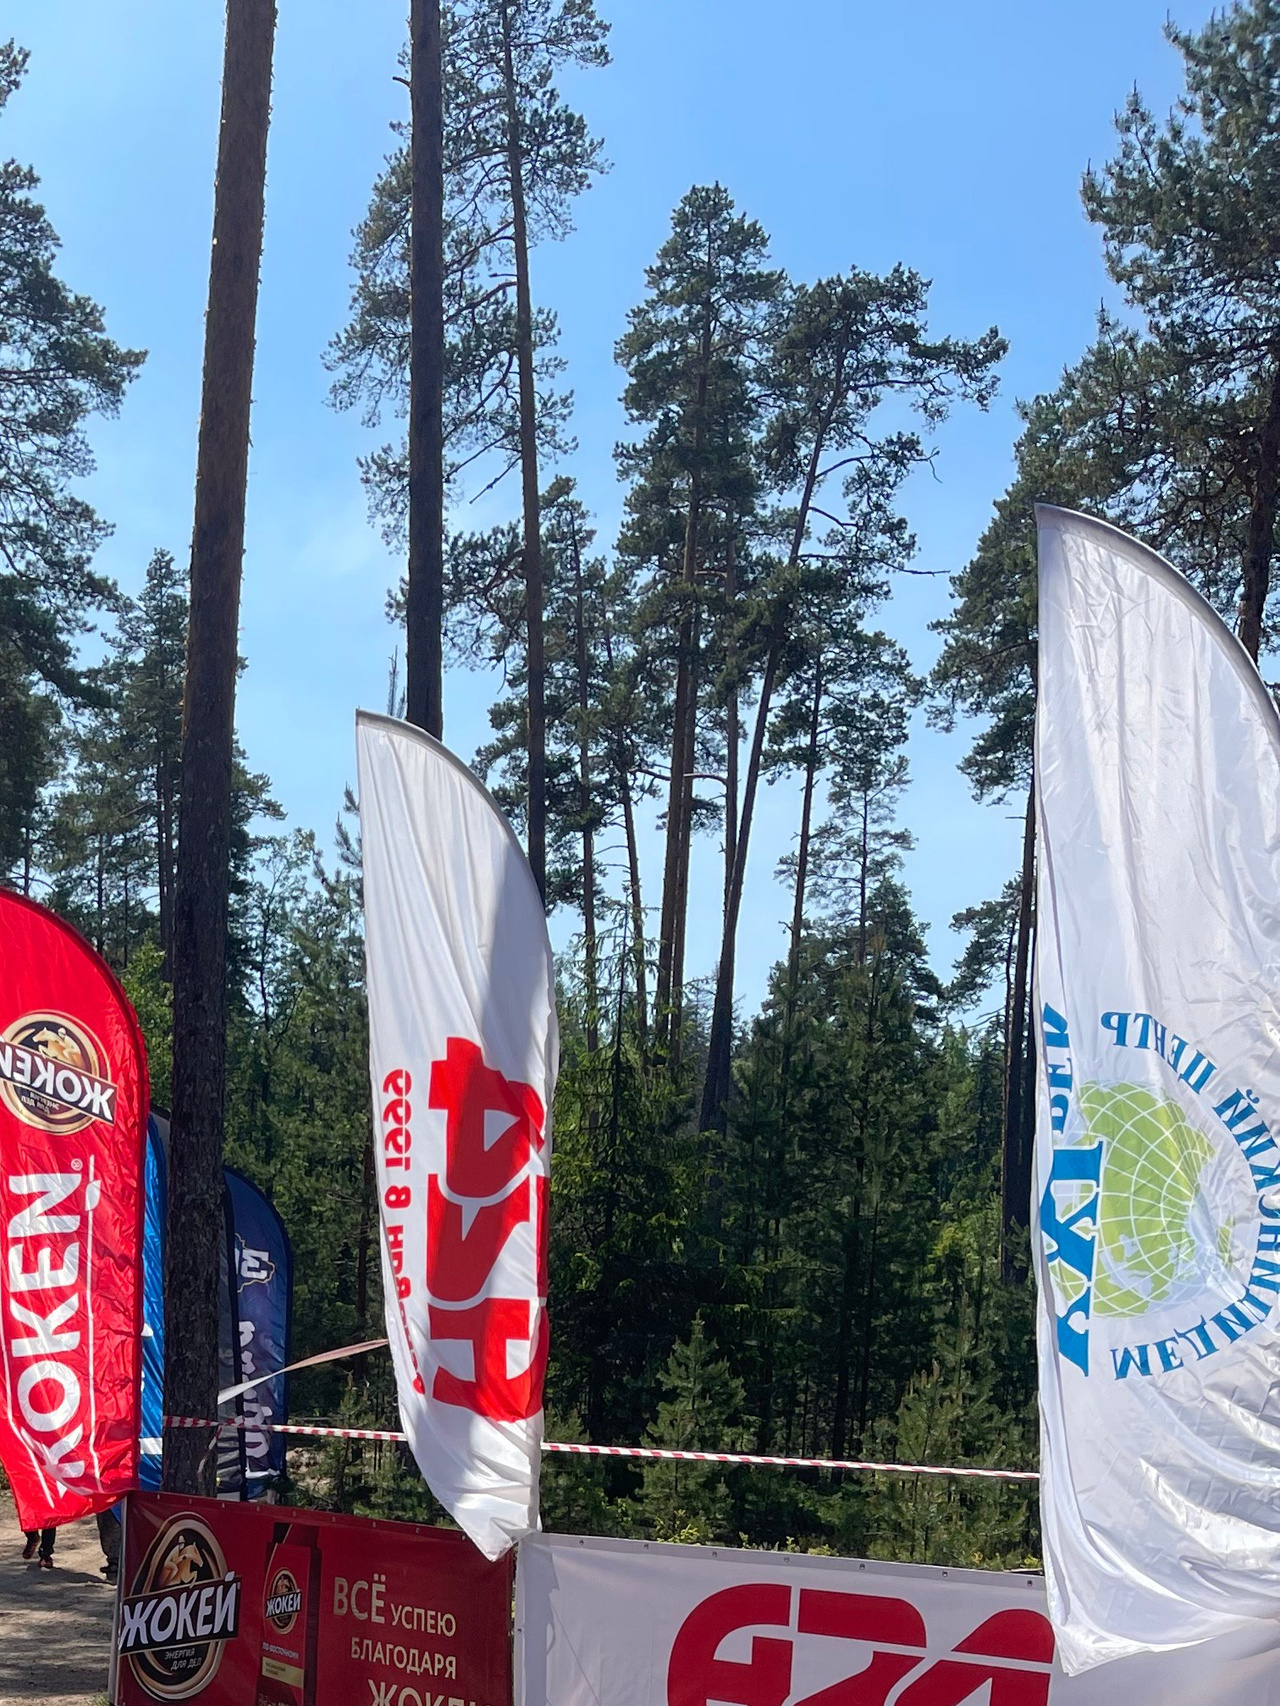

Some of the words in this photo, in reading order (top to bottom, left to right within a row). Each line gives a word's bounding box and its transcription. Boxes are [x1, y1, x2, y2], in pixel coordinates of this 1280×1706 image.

[118, 1571, 236, 1651] ЖОКЕЙ
[266, 1589, 301, 1617] ЖОКЕЙ
[333, 1573, 386, 1624] ВСЁ
[390, 1603, 457, 1637] УСПЕЮ
[351, 1636, 456, 1680] БЛАГОДАРЯ
